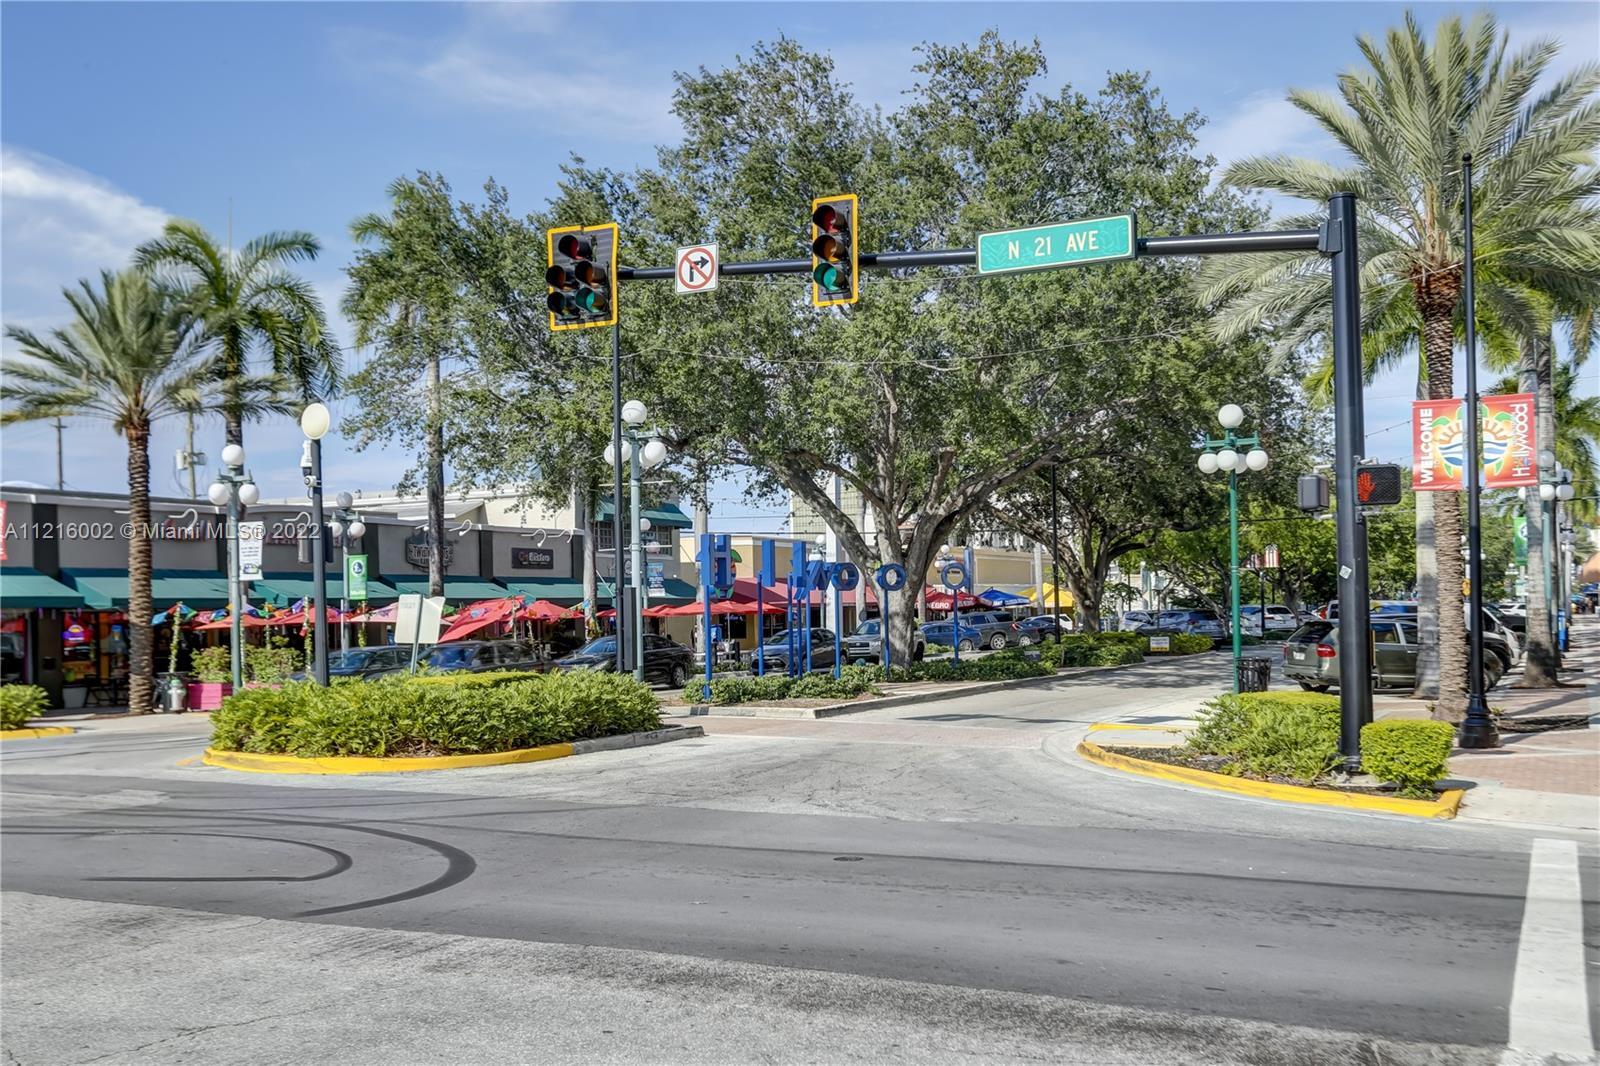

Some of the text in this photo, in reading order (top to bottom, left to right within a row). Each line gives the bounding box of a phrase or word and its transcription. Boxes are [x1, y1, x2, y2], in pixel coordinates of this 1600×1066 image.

[1008, 230, 1099, 260] N 21 AVE
[1420, 408, 1434, 484] WELCOME
[1511, 404, 1533, 477] Hollywood
